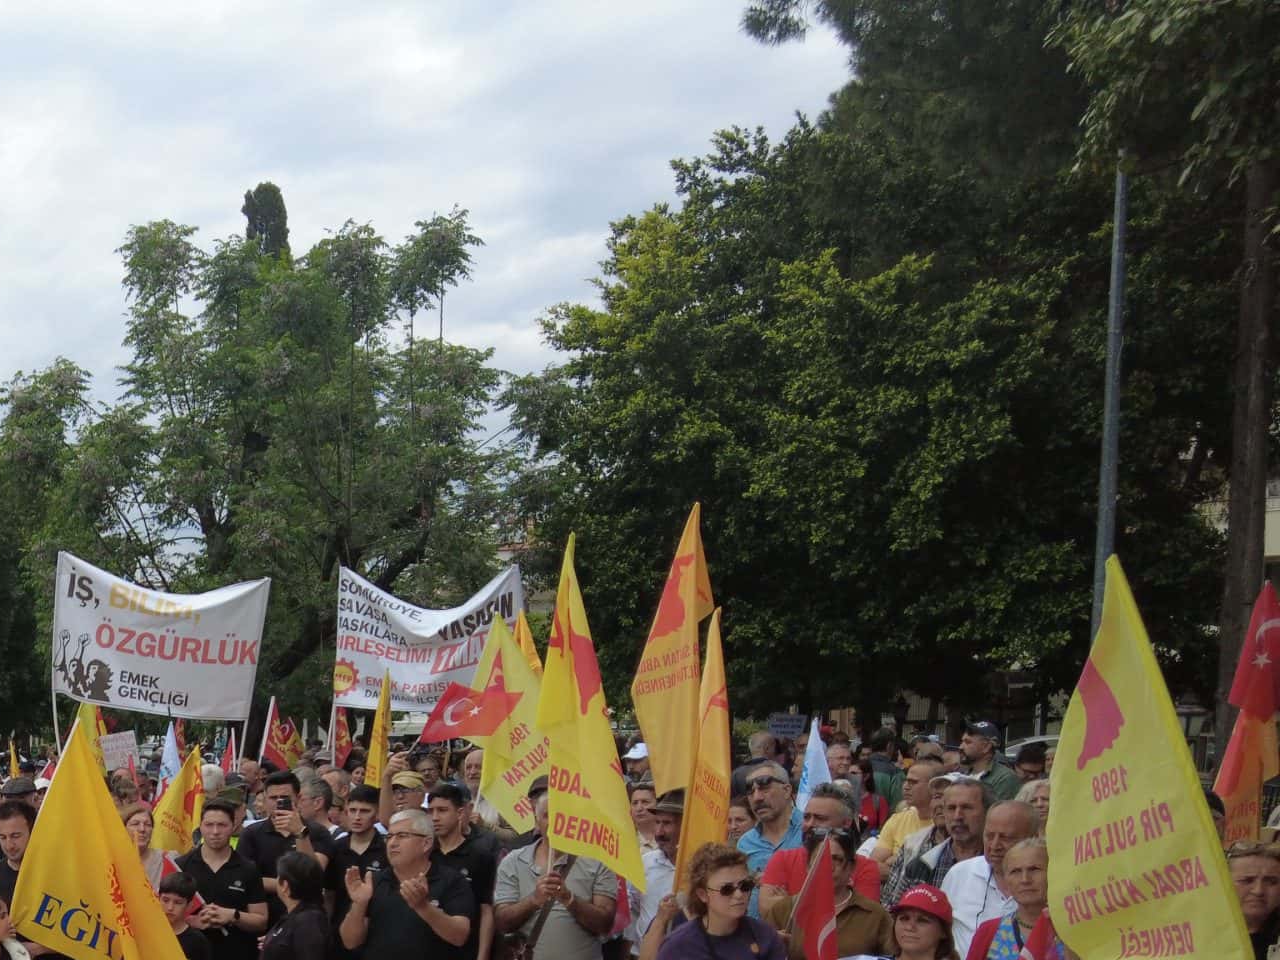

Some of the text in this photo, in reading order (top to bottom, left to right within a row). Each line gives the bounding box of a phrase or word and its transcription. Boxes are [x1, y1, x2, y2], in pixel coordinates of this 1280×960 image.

[67, 567, 100, 608] İŞ,
[95, 617, 258, 666] ÖZGÜRLÜK
[120, 670, 160, 689] EMEK
[366, 676, 397, 690] EMK
[118, 685, 189, 708] GENÇLİĞİ
